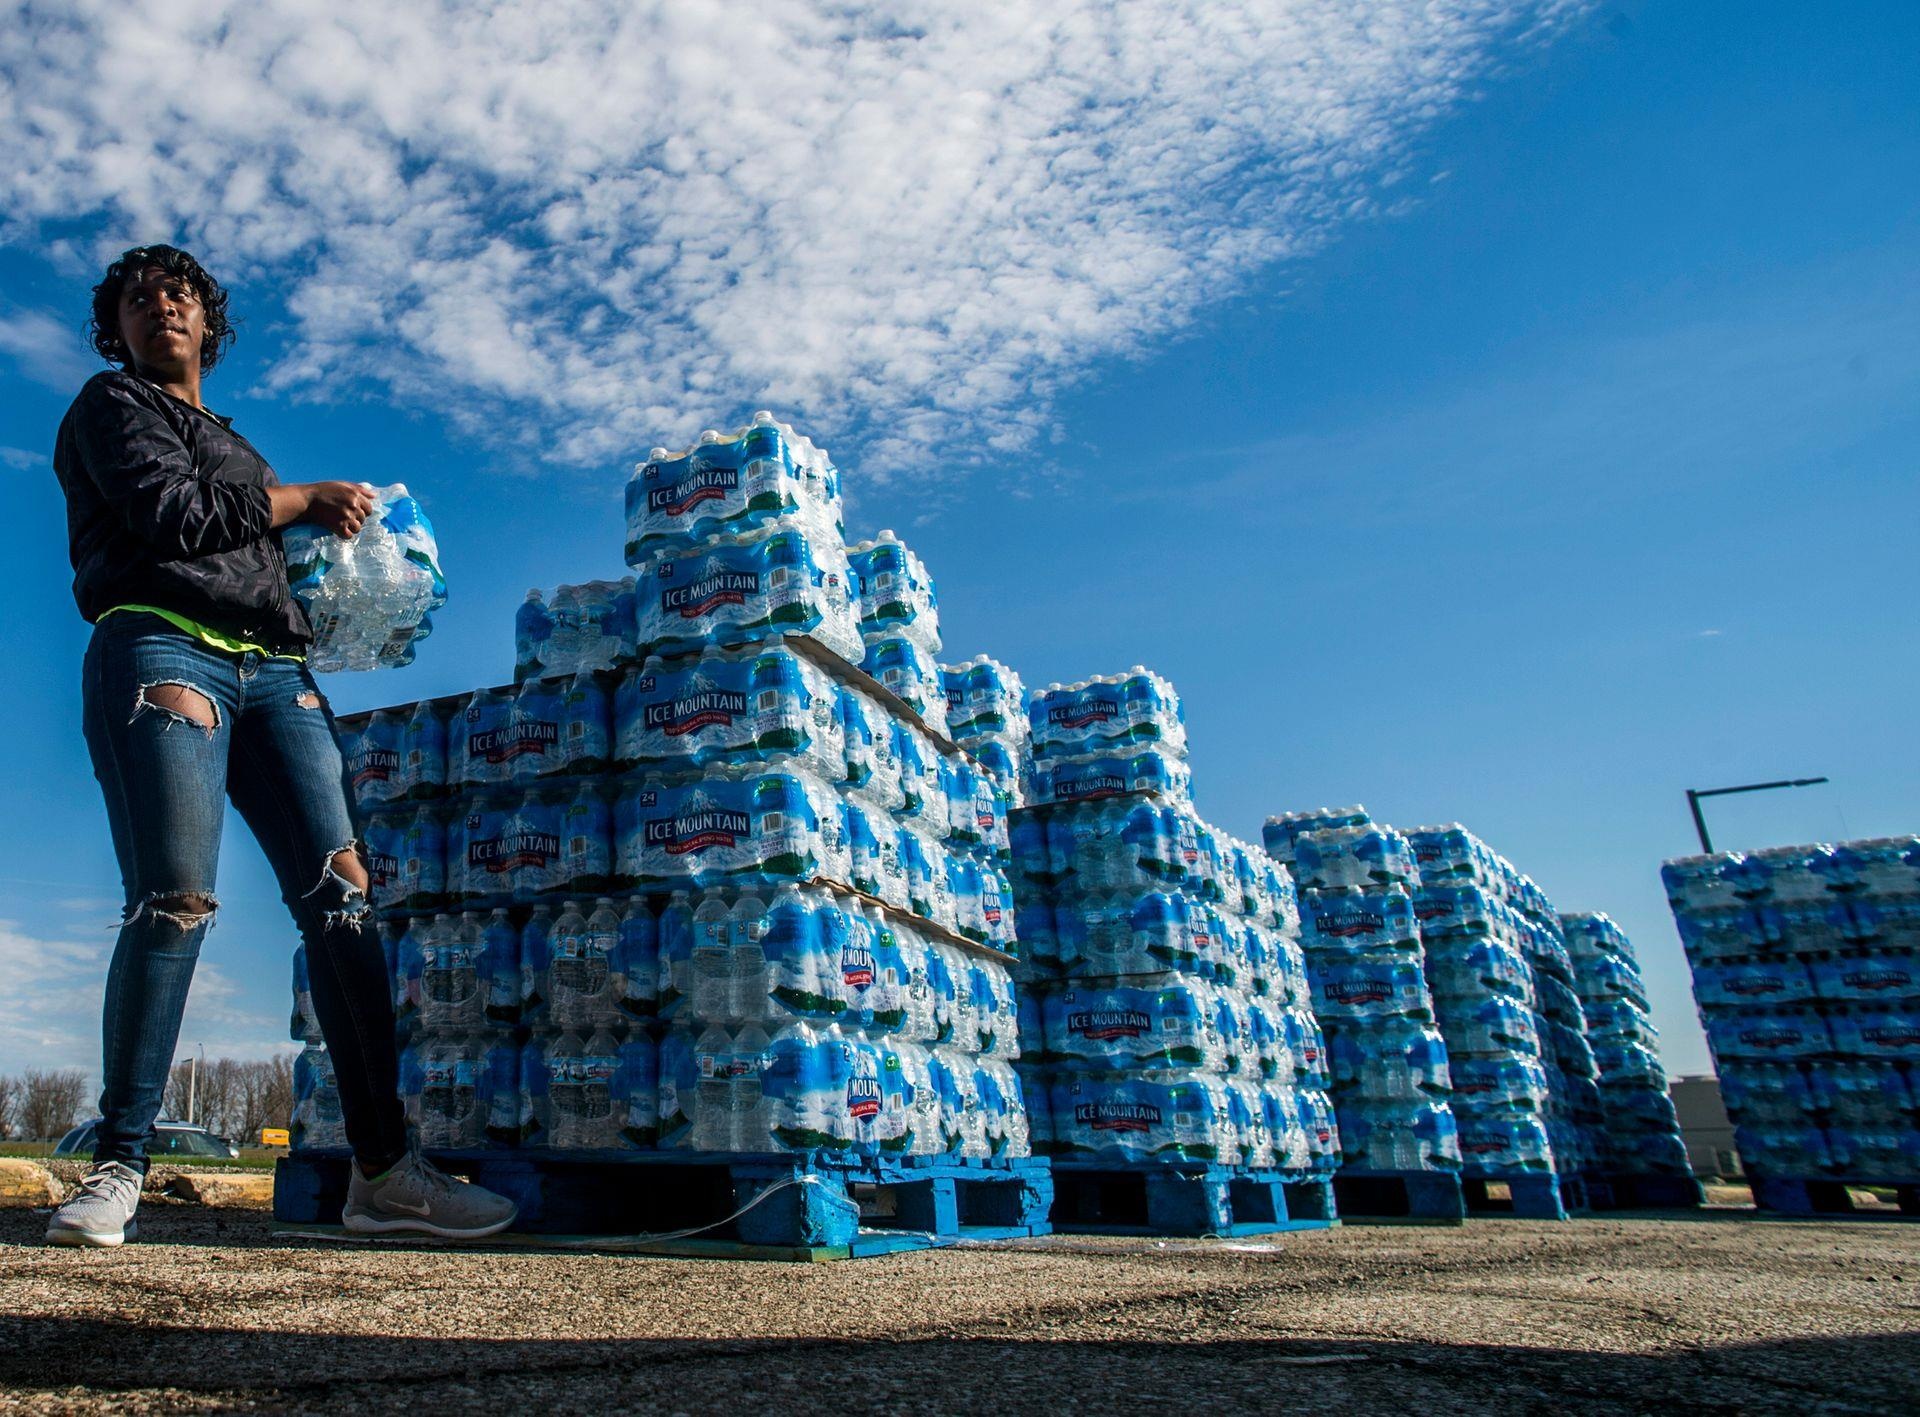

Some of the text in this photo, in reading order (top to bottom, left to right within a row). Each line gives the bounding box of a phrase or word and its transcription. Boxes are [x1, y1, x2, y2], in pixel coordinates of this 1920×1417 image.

[652, 489, 673, 507] ICE
[676, 472, 736, 499] MOUNTAIN
[665, 589, 687, 607] ICE
[690, 575, 756, 601] MOUNTAIN
[641, 678, 653, 688] 24
[648, 694, 743, 724] ICE MOUNTAIN
[1051, 703, 1116, 720] ICE MOUNTAIN
[473, 735, 493, 752] ICE
[495, 724, 555, 746] MOUNTAIN
[347, 753, 398, 773] MOUNTAIN
[1057, 777, 1124, 795] ICE MOUNTAIN
[641, 793, 655, 802] 24
[649, 813, 747, 840] ICE MOUNTAIN
[472, 836, 556, 860] ICE MOUNTAIN
[1070, 1013, 1149, 1028] ICE MOUNTAIN
[1077, 1105, 1159, 1121] ICE MOUNTAIN
